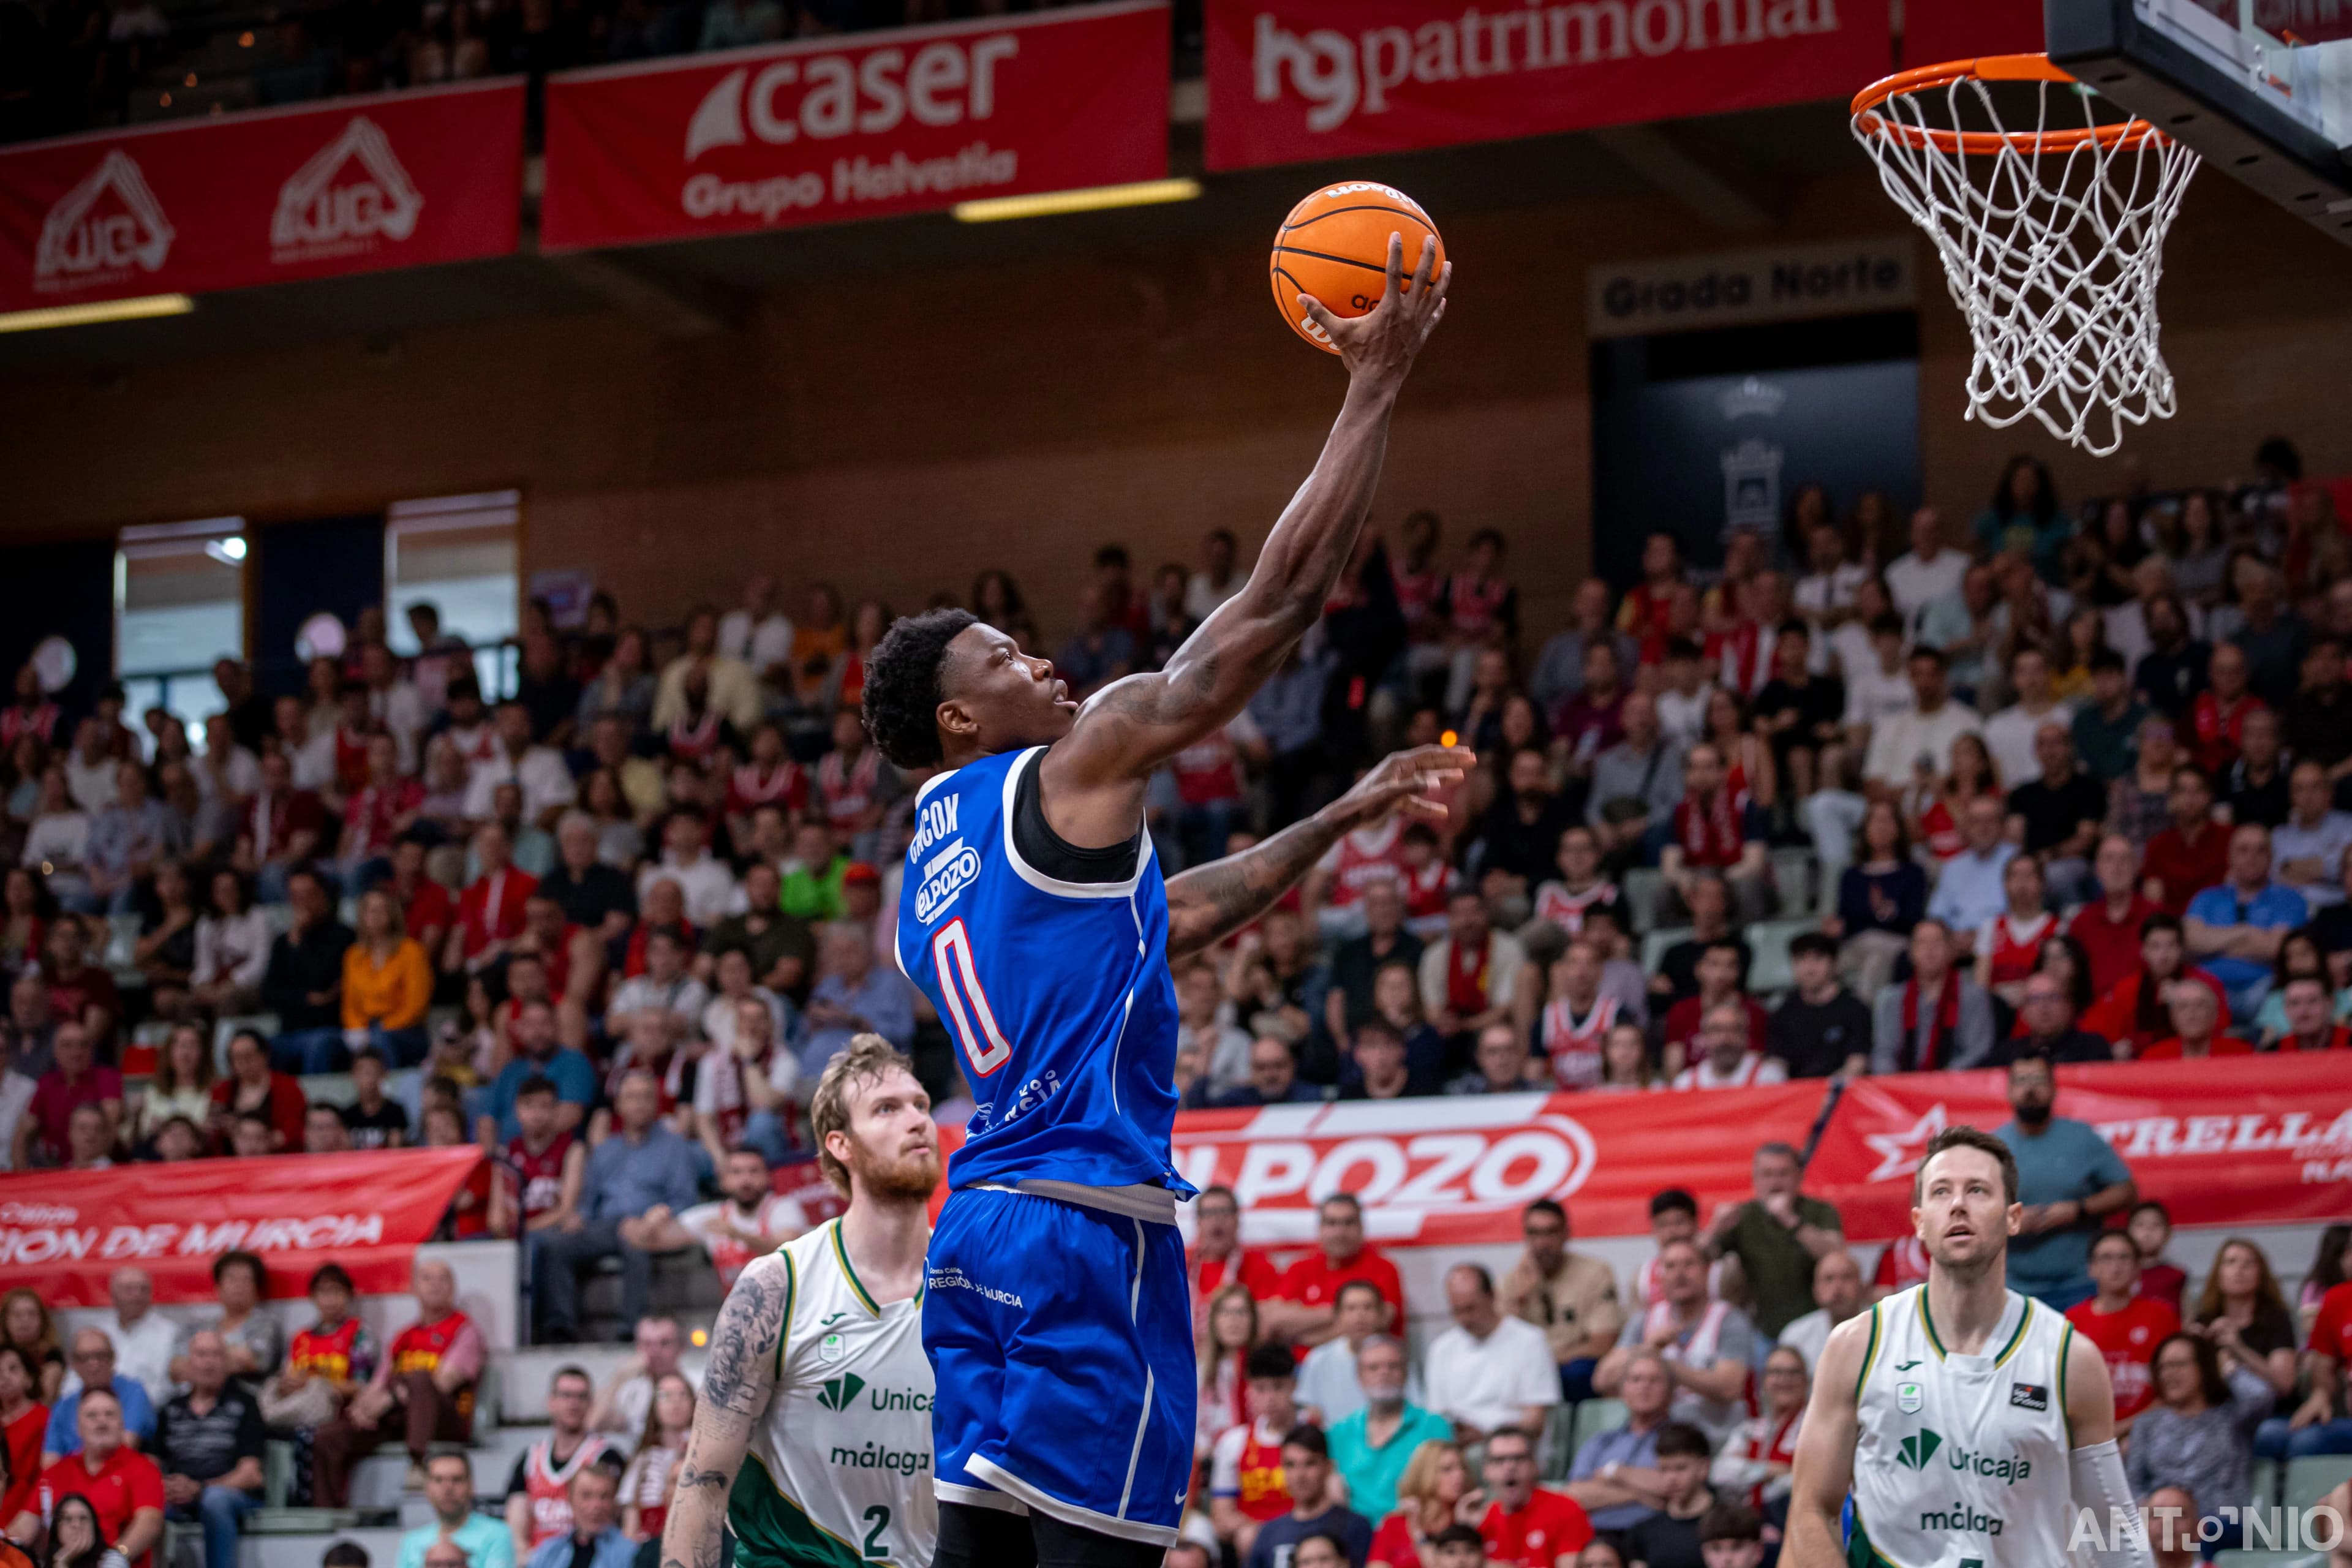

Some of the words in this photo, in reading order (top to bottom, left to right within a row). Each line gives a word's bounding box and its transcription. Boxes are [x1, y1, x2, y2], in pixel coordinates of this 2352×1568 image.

[748, 34, 1019, 145] caser
[682, 173, 825, 222] Grupo
[1603, 275, 1751, 318] Grada
[1771, 254, 1899, 299] Norte
[932, 916, 1012, 1078] 0
[100, 1223, 179, 1259] DE
[179, 1215, 383, 1255] MURCIA
[863, 1504, 891, 1558] 2
